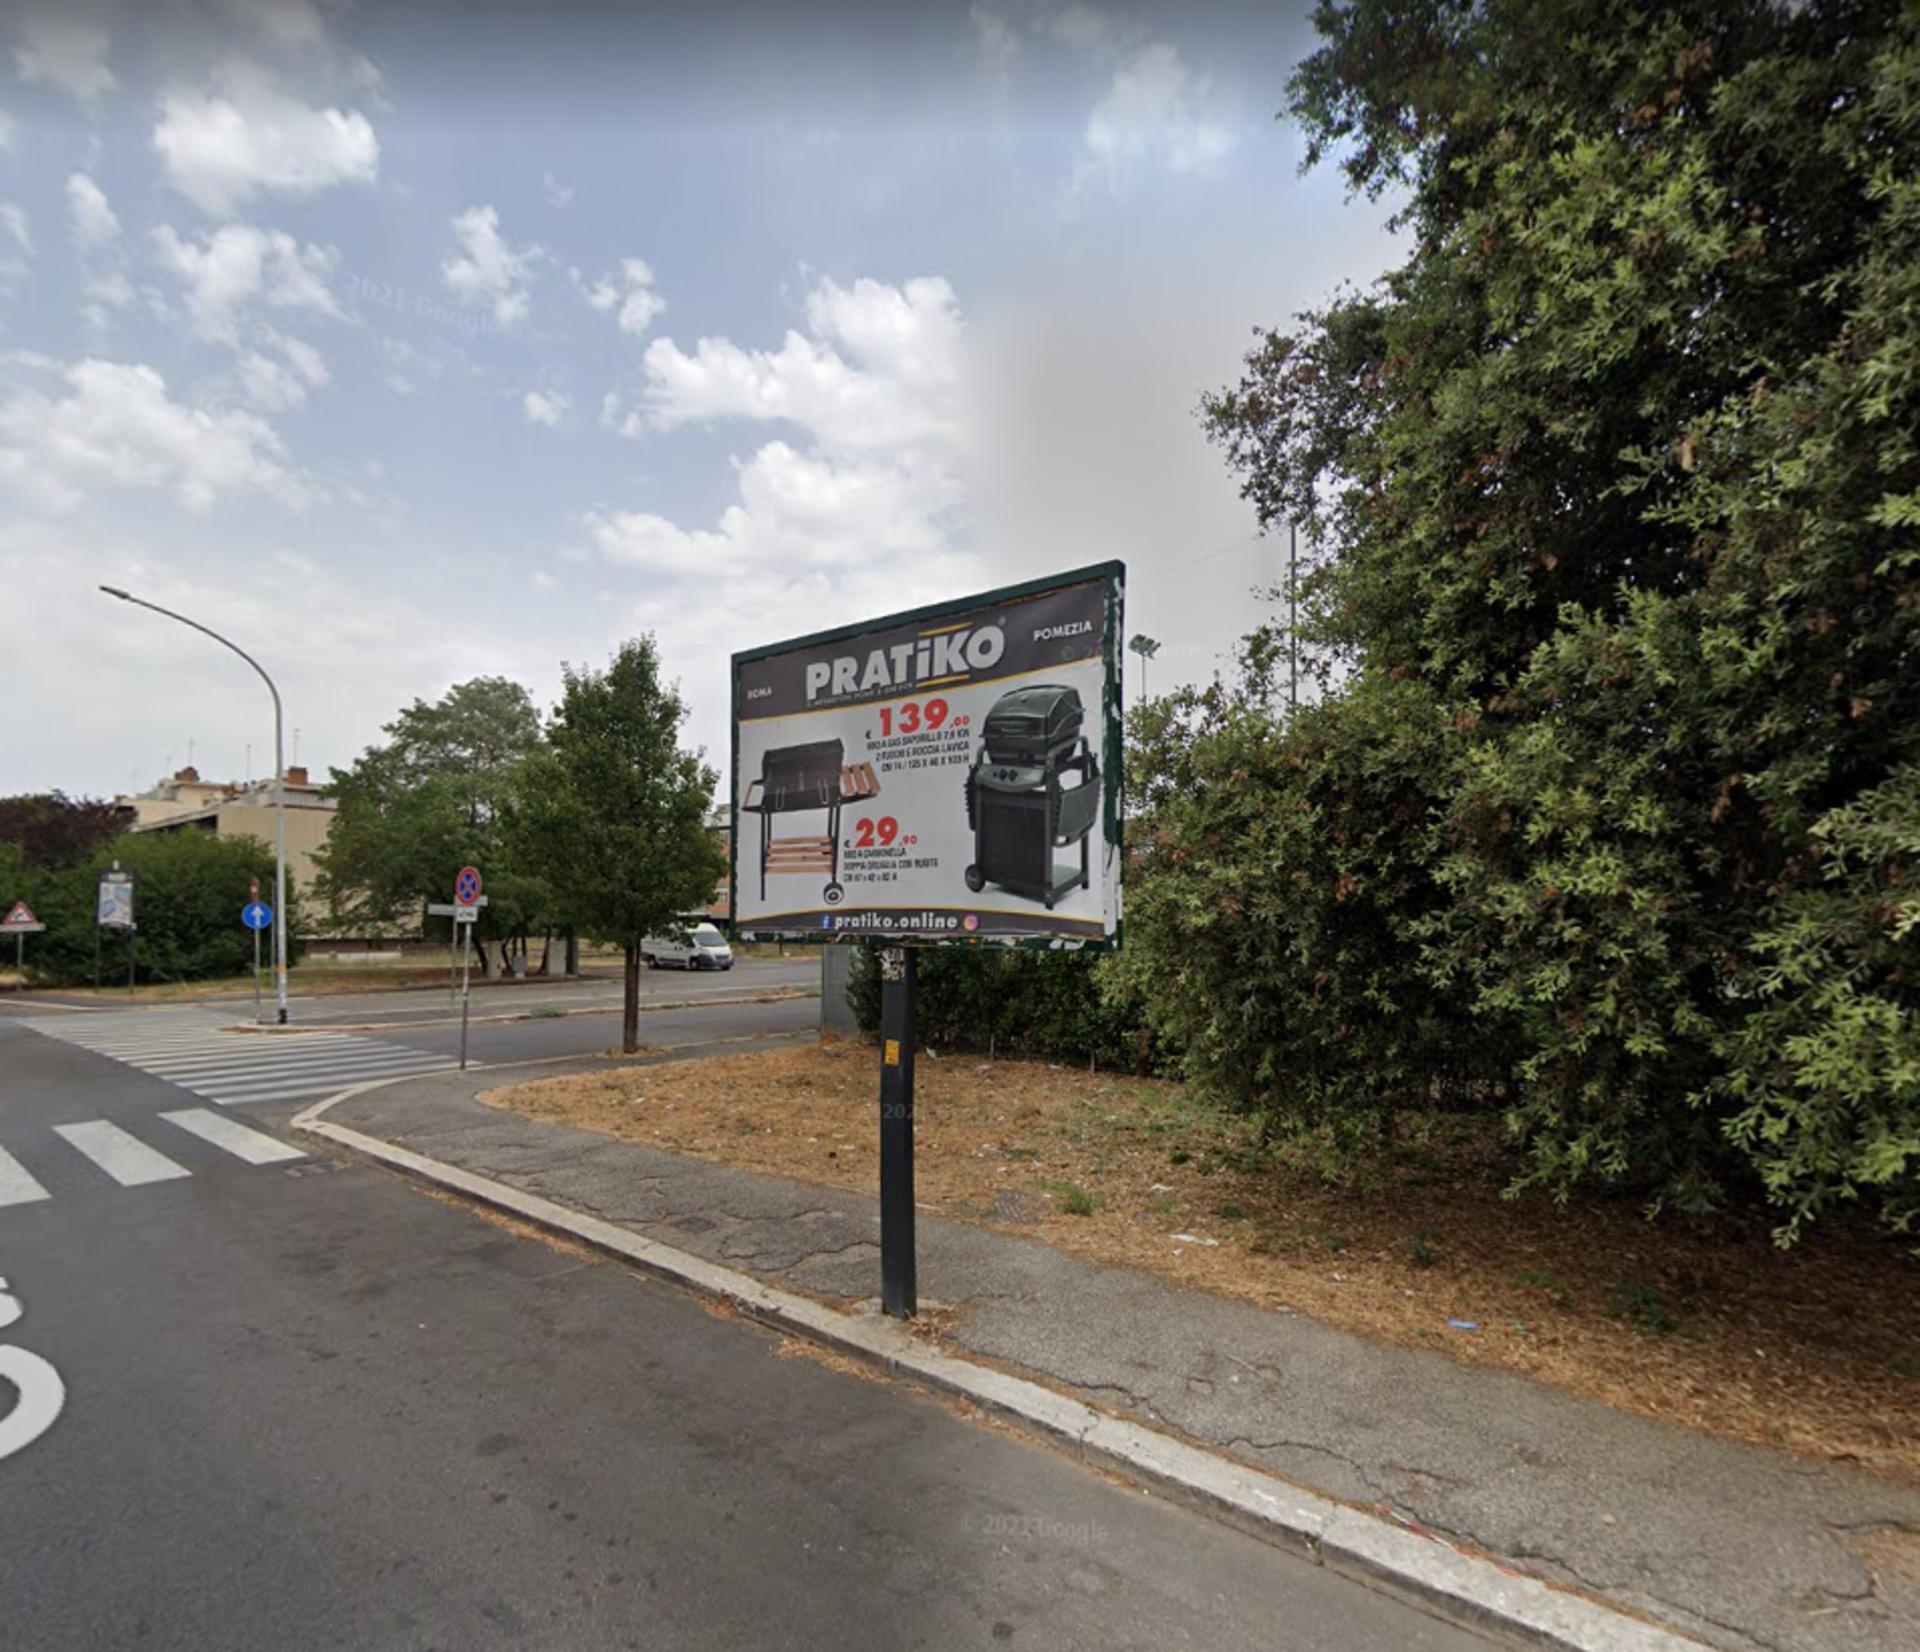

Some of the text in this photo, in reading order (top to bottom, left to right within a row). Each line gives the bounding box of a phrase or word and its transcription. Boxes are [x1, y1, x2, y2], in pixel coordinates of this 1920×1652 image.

[1033, 620, 1093, 641] POMEZIA
[747, 687, 772, 699] ROMA
[941, 741, 970, 754] LAVICA
[835, 912, 958, 930] pratiko.online
